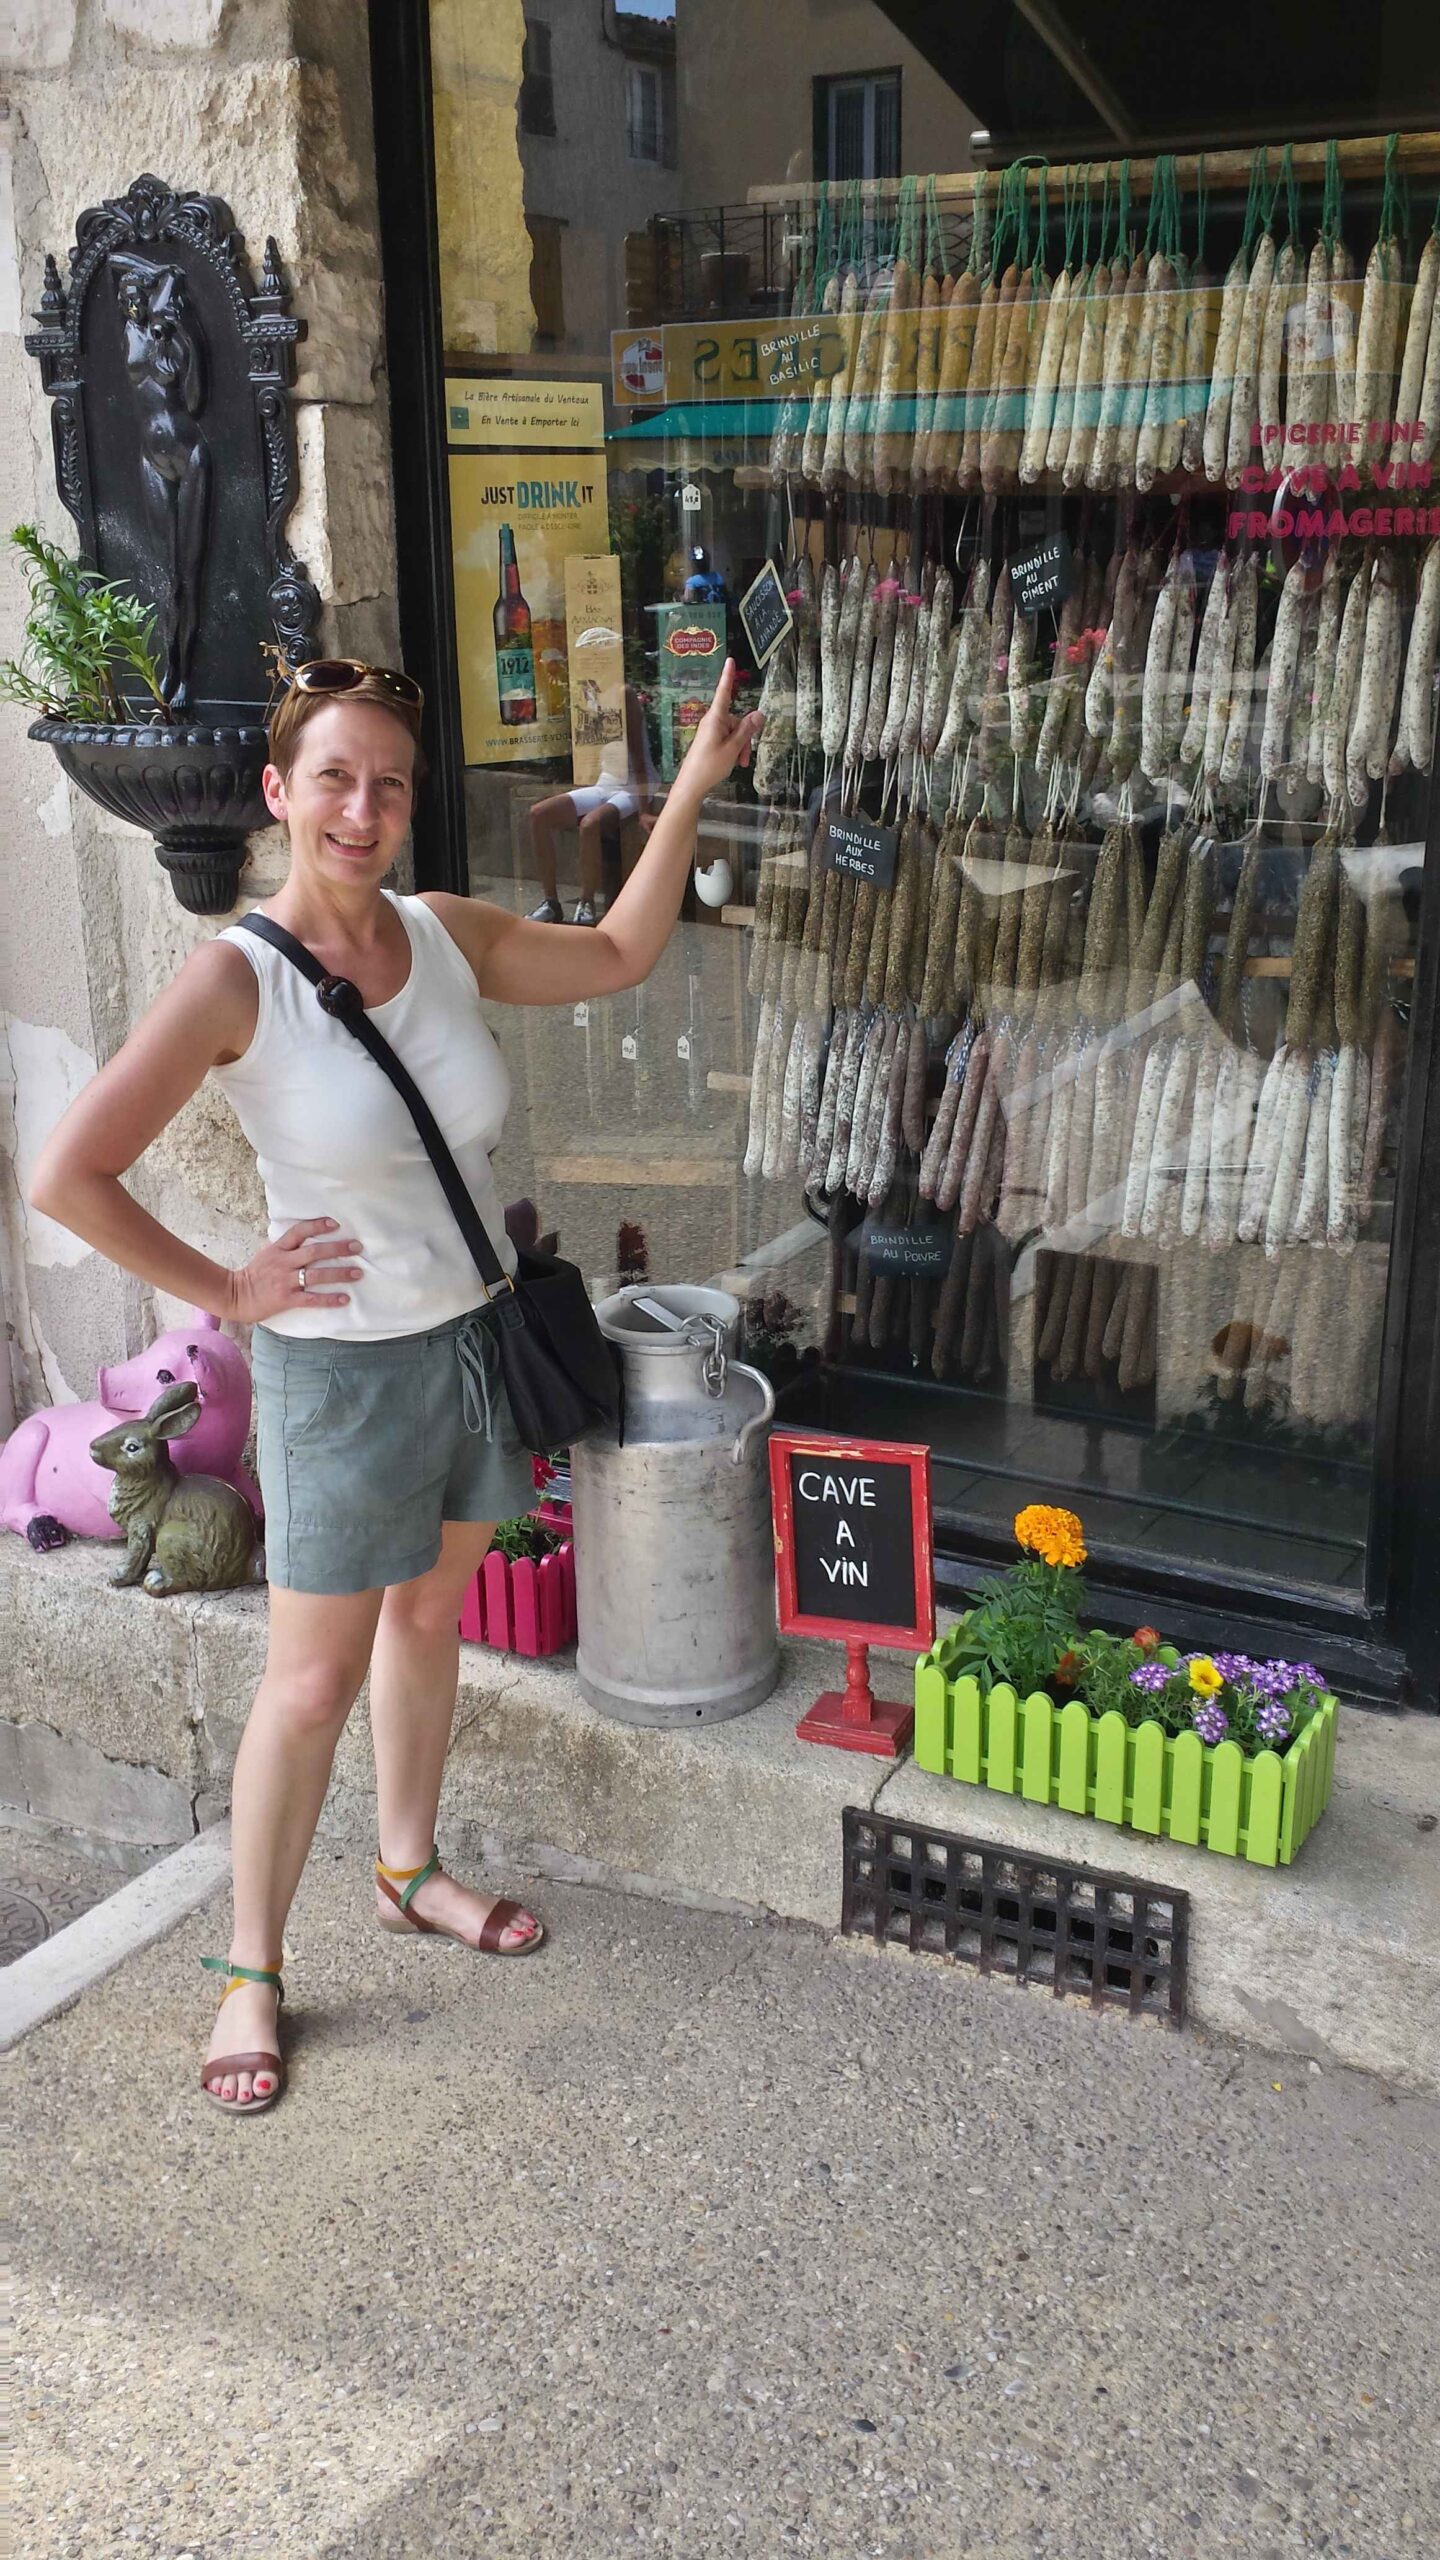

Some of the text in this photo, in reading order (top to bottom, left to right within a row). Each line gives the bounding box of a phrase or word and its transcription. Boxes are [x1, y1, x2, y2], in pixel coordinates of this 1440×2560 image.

[761, 324, 820, 356] BRINDILLE
[781, 351, 794, 364] AU
[769, 357, 819, 385] BASILIC
[465, 392, 589, 405] La Bière Artisanale du Ventoux
[481, 415, 580, 428] En Vente à Emporter Ici
[1367, 420, 1426, 444] FINE
[1240, 463, 1329, 494] CAVE
[1372, 459, 1433, 490] VIN
[481, 481, 594, 509] JUST DRINK IT
[1228, 507, 1440, 539] FROMAGERIE
[1011, 546, 1060, 580] BRINDILLE
[1021, 575, 1059, 603] PIMENT
[1026, 572, 1038, 586] AU
[500, 657, 530, 675] 1912
[829, 825, 881, 851] BRINDILLE
[845, 844, 863, 857] AUX
[835, 853, 875, 875] HERBES
[870, 1235, 933, 1245] BRINDILLE
[882, 1248, 942, 1262] AU POIVRE
[798, 1472, 876, 1506] CAVE
[836, 1519, 855, 1547] A
[819, 1556, 868, 1587] VIN
